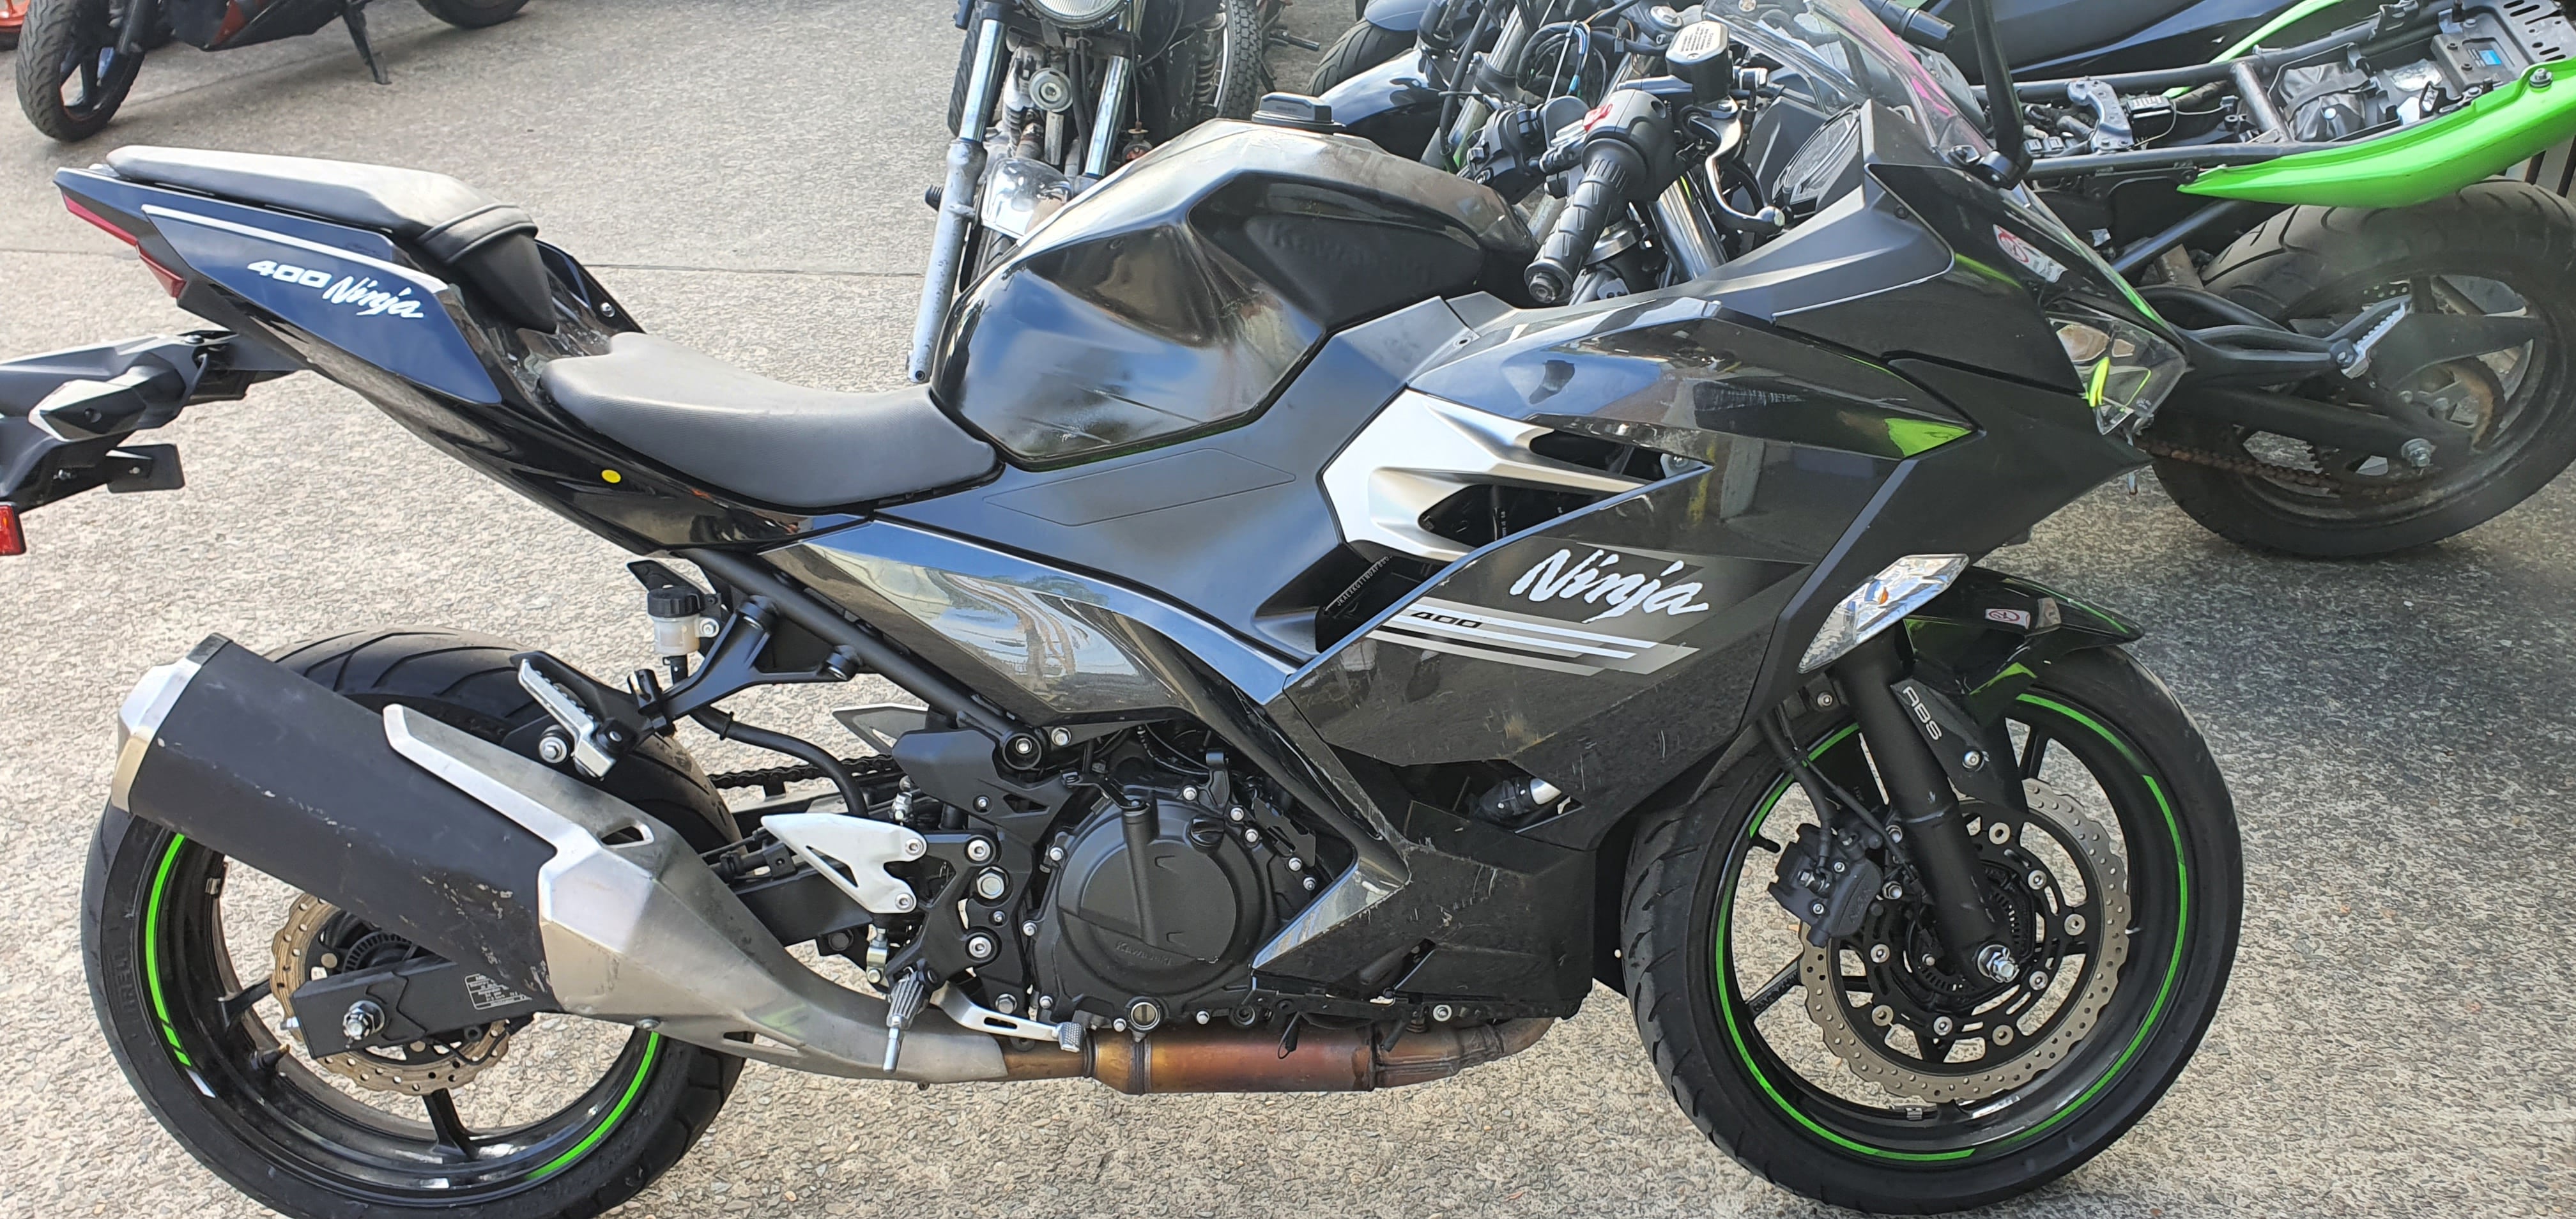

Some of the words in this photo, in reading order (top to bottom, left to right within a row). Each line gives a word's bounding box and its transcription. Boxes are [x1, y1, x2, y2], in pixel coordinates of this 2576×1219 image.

[247, 260, 332, 288] 400
[322, 276, 424, 318] Ninja
[1509, 549, 1710, 624] Ninja
[1411, 611, 1483, 629] 400
[1902, 686, 1943, 740] ABS
